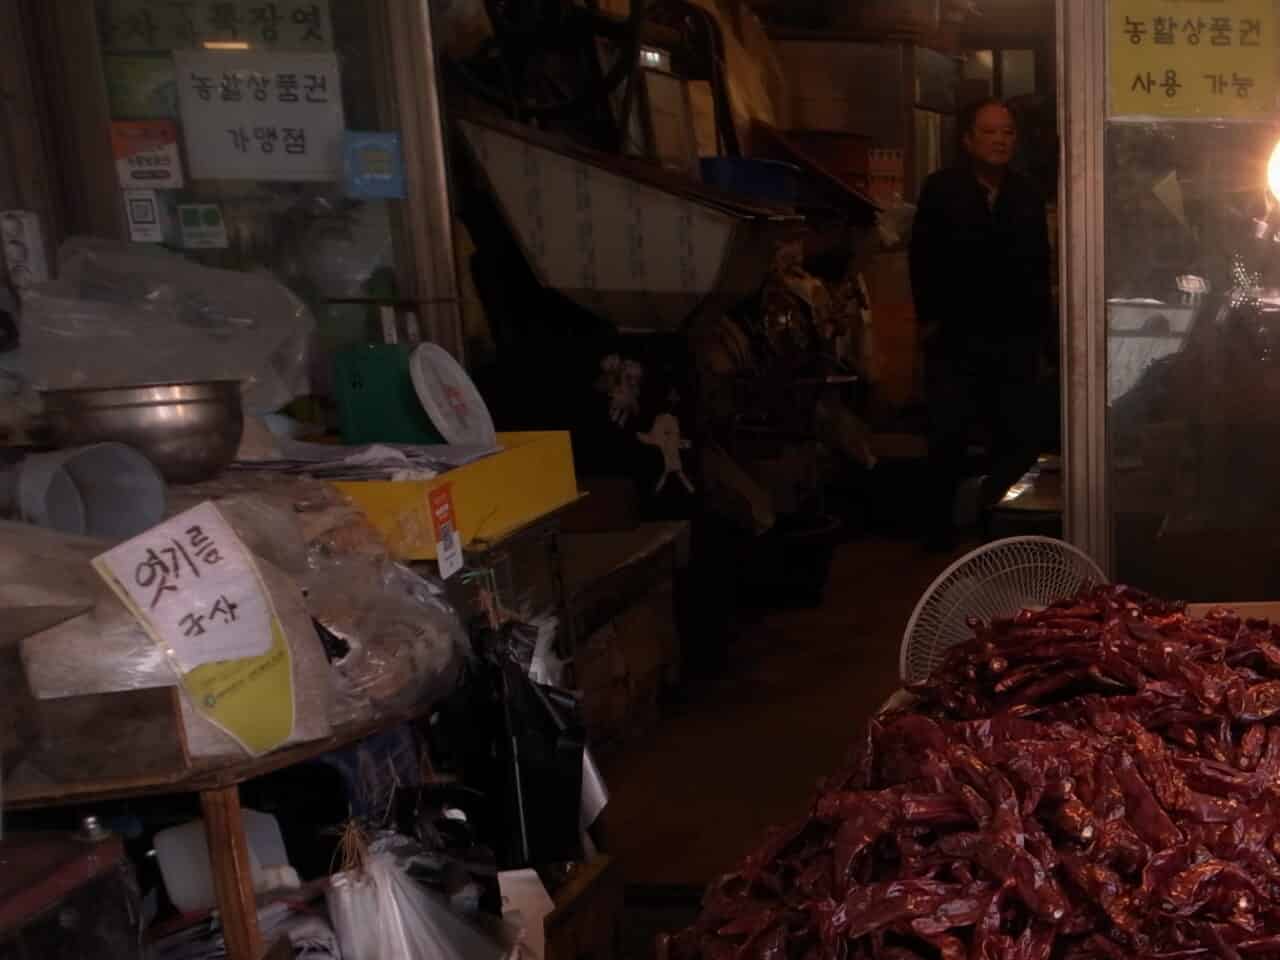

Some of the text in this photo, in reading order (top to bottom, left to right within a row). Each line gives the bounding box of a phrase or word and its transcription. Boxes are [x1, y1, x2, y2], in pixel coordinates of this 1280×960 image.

[1131, 69, 1255, 98] 사용 가능
[226, 127, 307, 156] 가맹점
[133, 523, 226, 608] 엿기름
[178, 594, 242, 640] 국산
